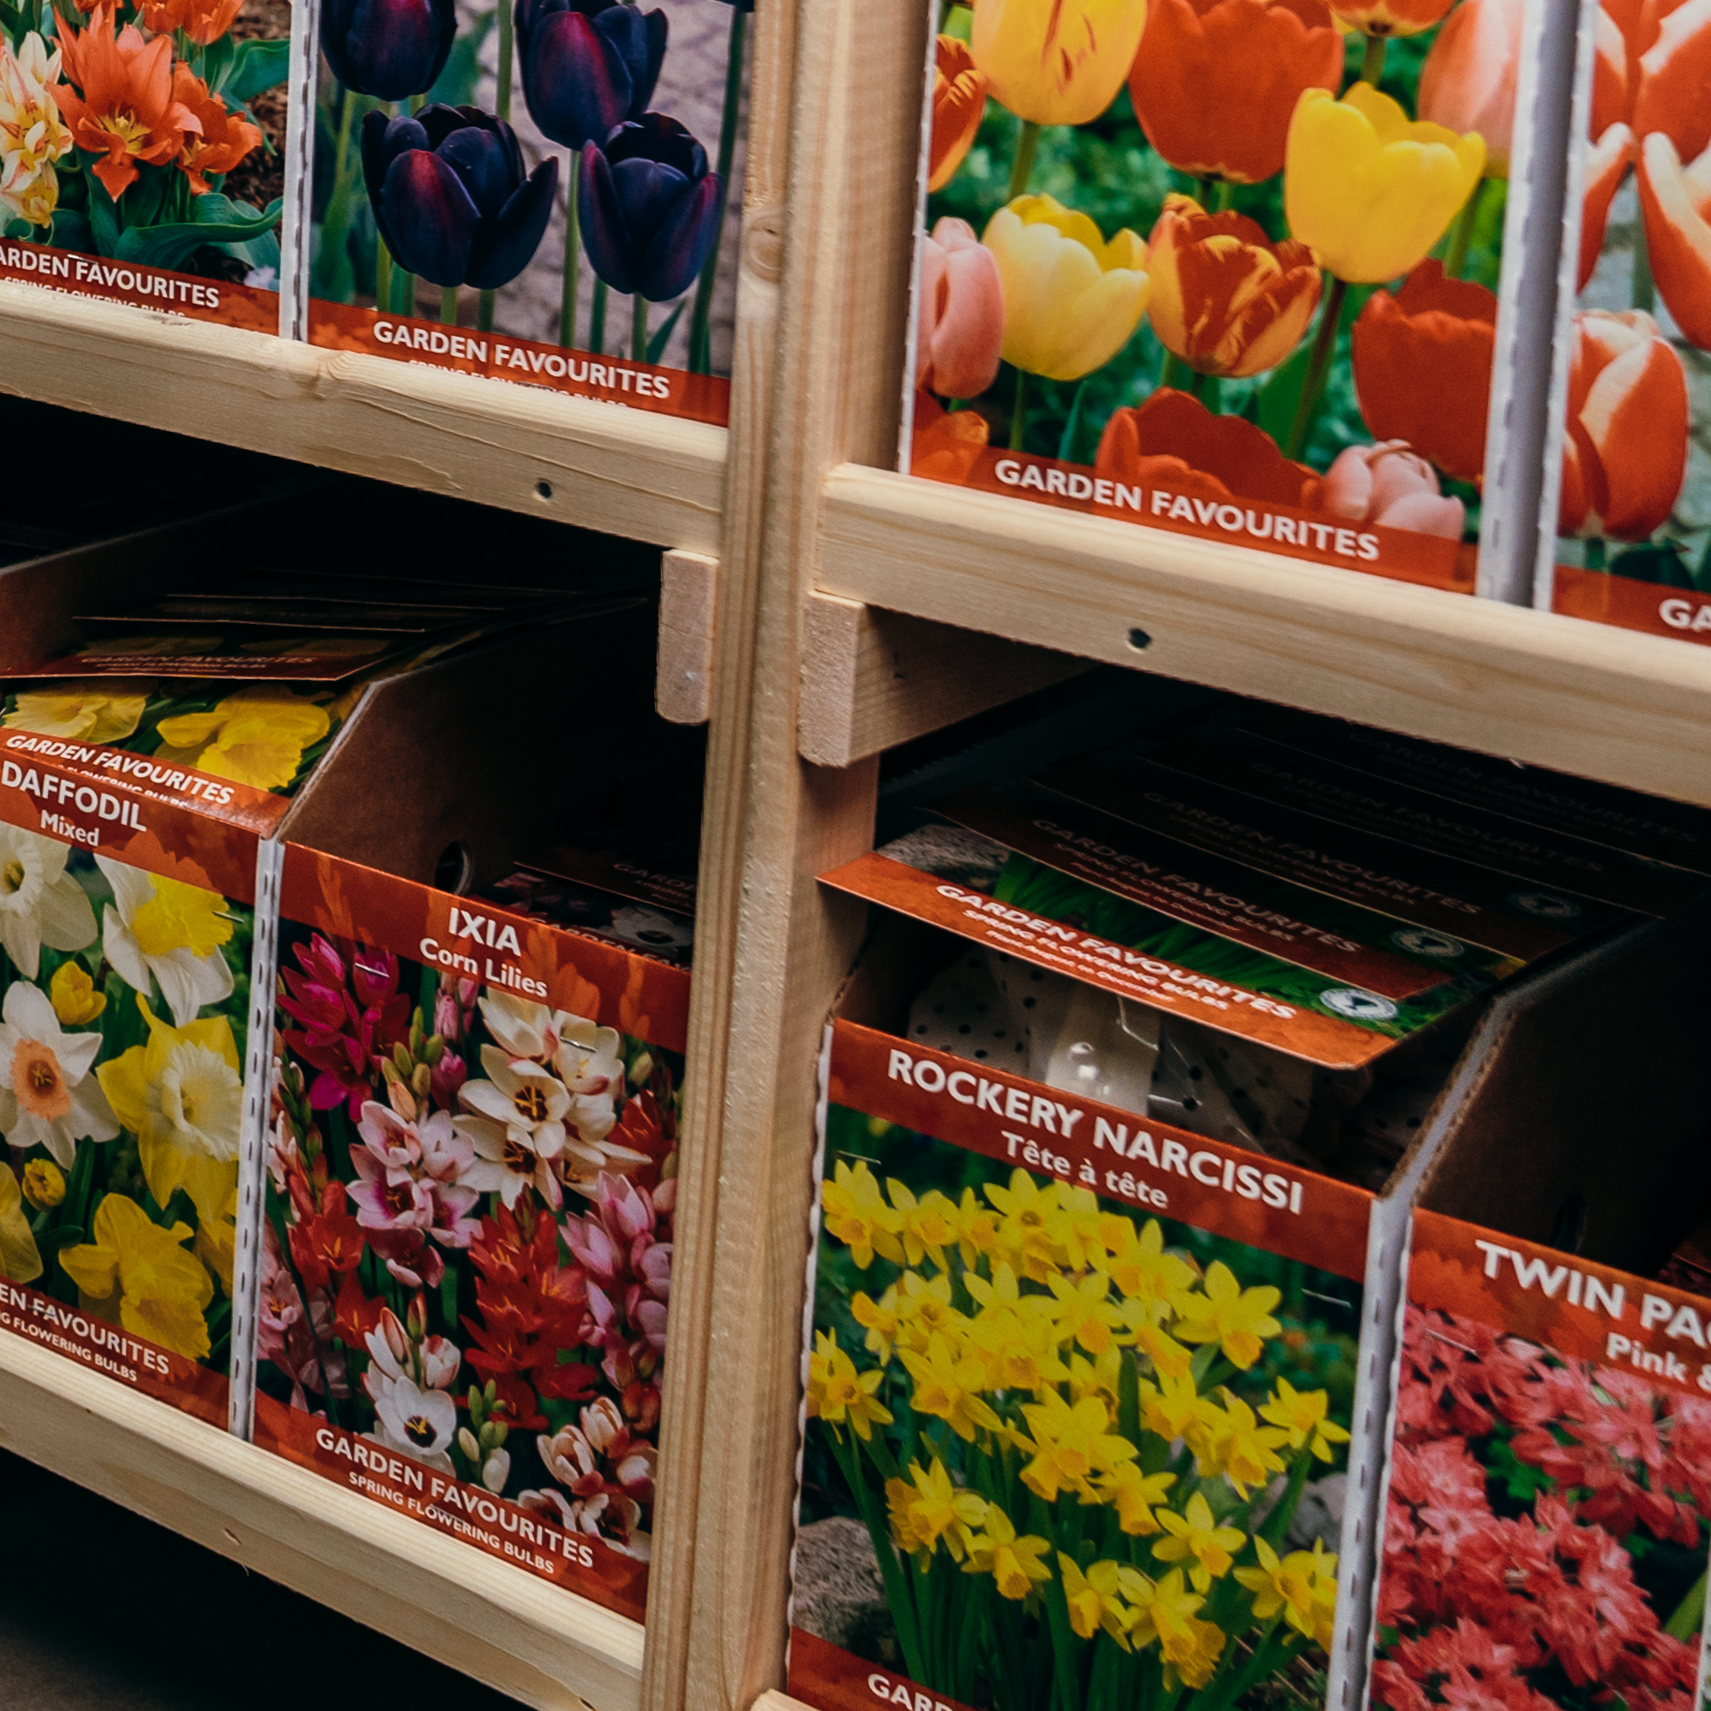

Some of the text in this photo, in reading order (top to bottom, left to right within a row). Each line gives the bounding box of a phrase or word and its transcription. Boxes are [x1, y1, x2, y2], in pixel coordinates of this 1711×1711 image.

[76, 261, 219, 308] FAVOURITES
[373, 321, 486, 363] GARDEN
[495, 345, 670, 399] FAVOURITES
[994, 459, 1380, 560] GARDEN FAVOURITES
[1, 760, 148, 833] DAFFODIL
[6, 735, 96, 766] GARDEN
[93, 750, 235, 805] FAVOURITES
[40, 813, 100, 847] Mixed
[449, 906, 522, 957] IXIA
[936, 884, 1297, 1020] GARDEN FAVOURITES
[962, 910, 1035, 941] SPRING
[419, 937, 549, 999] Corn Lilies
[887, 1050, 1304, 1214] ROCKERY NARCISSI
[1001, 1131, 1169, 1209] Tête à tête
[1474, 1239, 1623, 1320] TWIN
[13, 1315, 92, 1363] FLOWERING
[94, 1351, 138, 1383] BULBS
[31, 1297, 170, 1376] FAVOURITES
[1607, 1332, 1688, 1384] Pink
[316, 1428, 594, 1570] GARDEN FAVOURITES
[348, 1471, 555, 1575] SPRING FLOWERING BULBS
